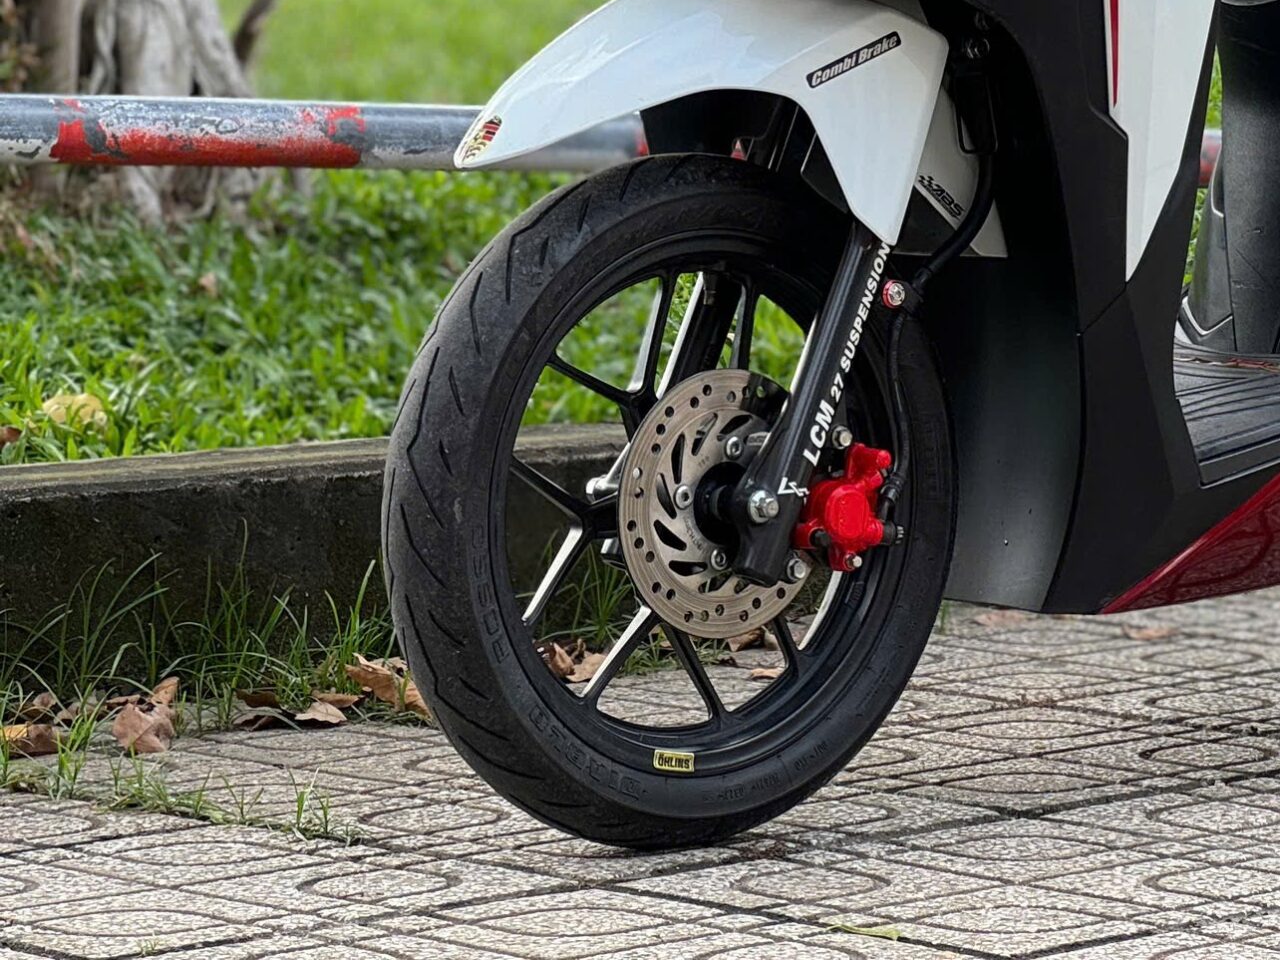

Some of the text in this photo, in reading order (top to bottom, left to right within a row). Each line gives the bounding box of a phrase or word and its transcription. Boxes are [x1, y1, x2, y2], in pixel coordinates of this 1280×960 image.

[811, 35, 899, 87] Combi Brake
[803, 241, 892, 466] LCM 27 SUSPENSION
